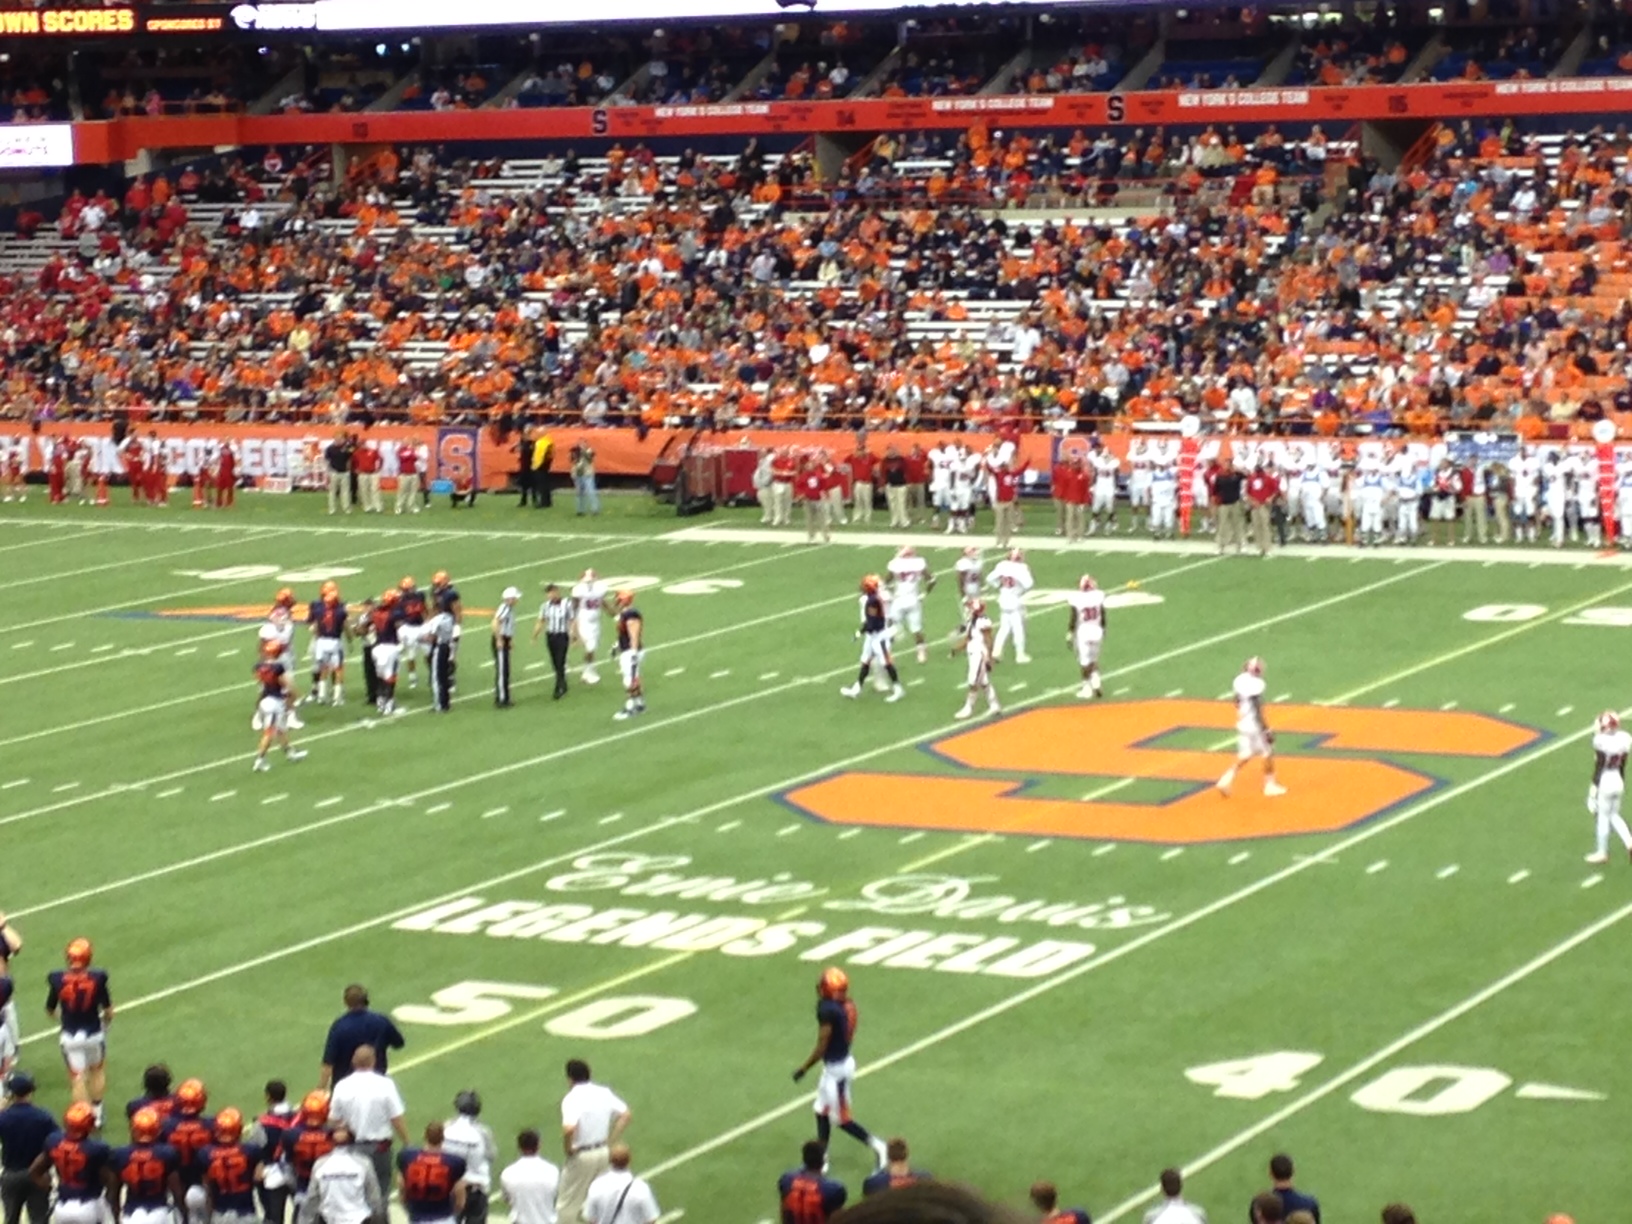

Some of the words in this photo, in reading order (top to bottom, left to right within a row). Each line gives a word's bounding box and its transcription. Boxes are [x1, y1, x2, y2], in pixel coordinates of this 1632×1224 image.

[42, 9, 134, 32] SCORES
[592, 109, 608, 134] S
[1108, 95, 1126, 122] S
[777, 699, 1554, 843] S
[390, 897, 827, 956] LEGENDS
[799, 926, 1096, 977] FIELD
